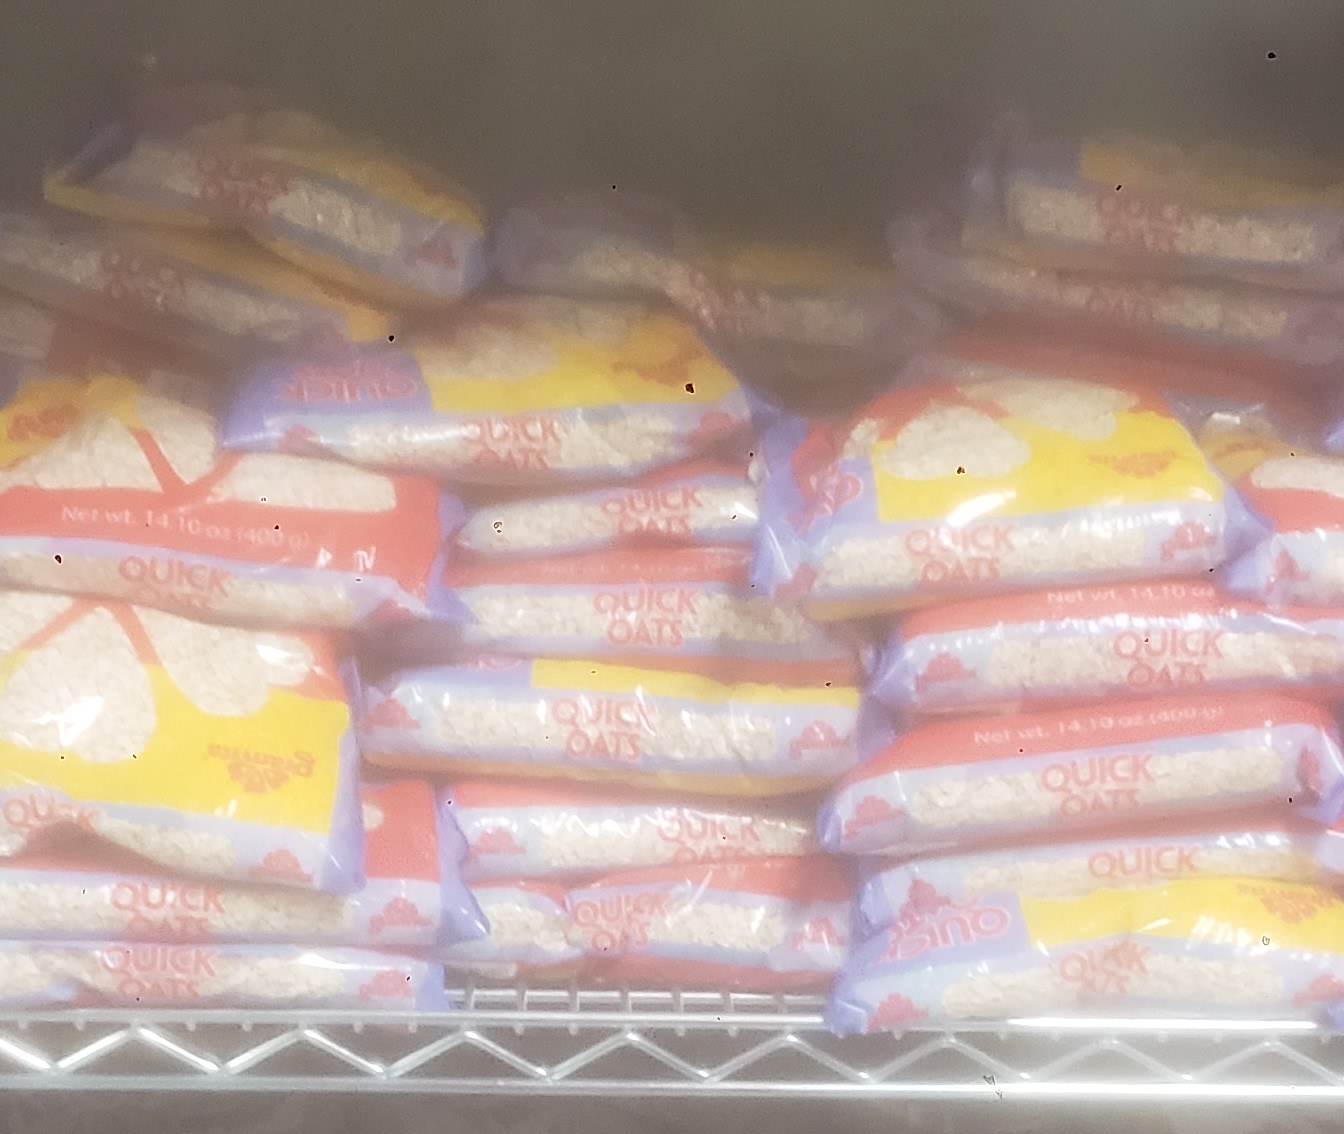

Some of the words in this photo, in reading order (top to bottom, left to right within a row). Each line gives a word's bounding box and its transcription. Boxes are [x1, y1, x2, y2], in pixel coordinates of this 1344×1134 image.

[61, 506, 98, 522] Net
[118, 555, 231, 598] QUICK
[592, 586, 700, 615] QUICK
[1047, 590, 1083, 604] Net
[607, 616, 687, 648] OATS
[1113, 628, 1225, 660] QUICK
[564, 730, 642, 762] OATS
[973, 728, 1012, 745] Net
[1040, 752, 1155, 793] QUICK
[1060, 788, 1139, 818] OATS
[1088, 845, 1204, 879] QUICK
[111, 881, 226, 914] QUICK
[100, 945, 217, 978] QUICK
